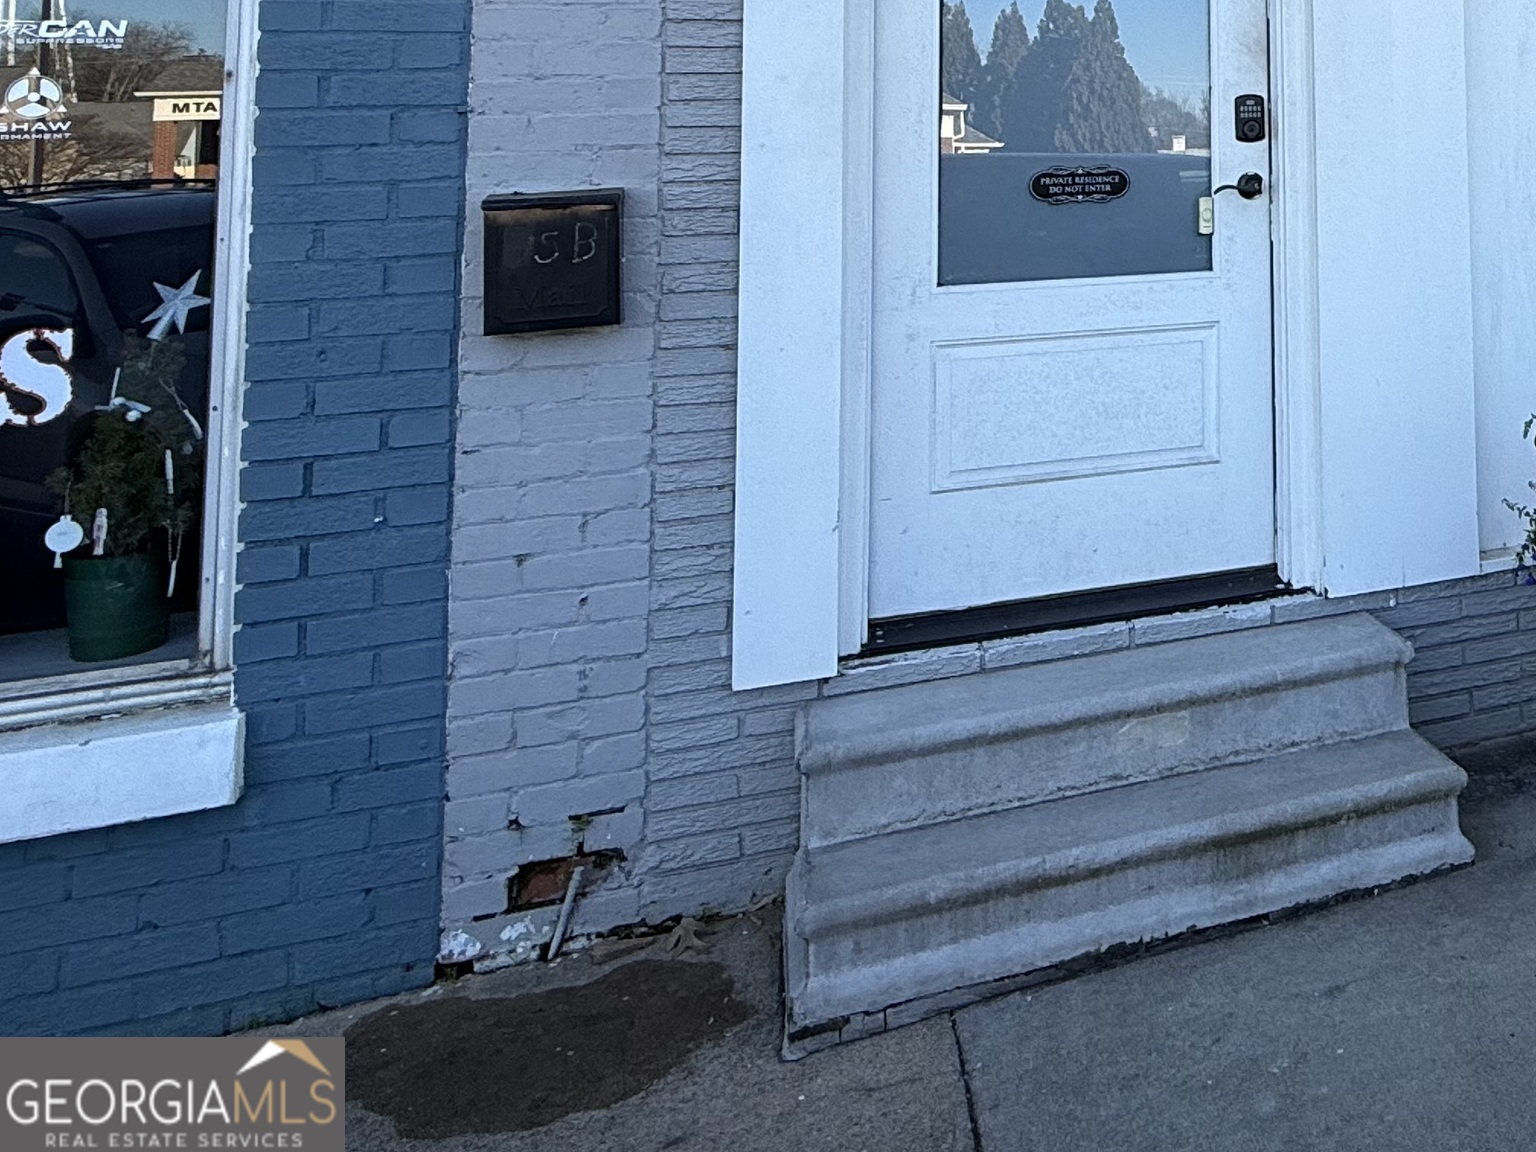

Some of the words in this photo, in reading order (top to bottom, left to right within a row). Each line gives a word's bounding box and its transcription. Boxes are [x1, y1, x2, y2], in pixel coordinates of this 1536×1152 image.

[1040, 176, 1073, 185] PRIVATE
[1074, 175, 1120, 183] RESIDENCE
[1048, 186, 1063, 194] DO
[1063, 185, 1084, 193] NOT
[1084, 184, 1112, 192] ENTER
